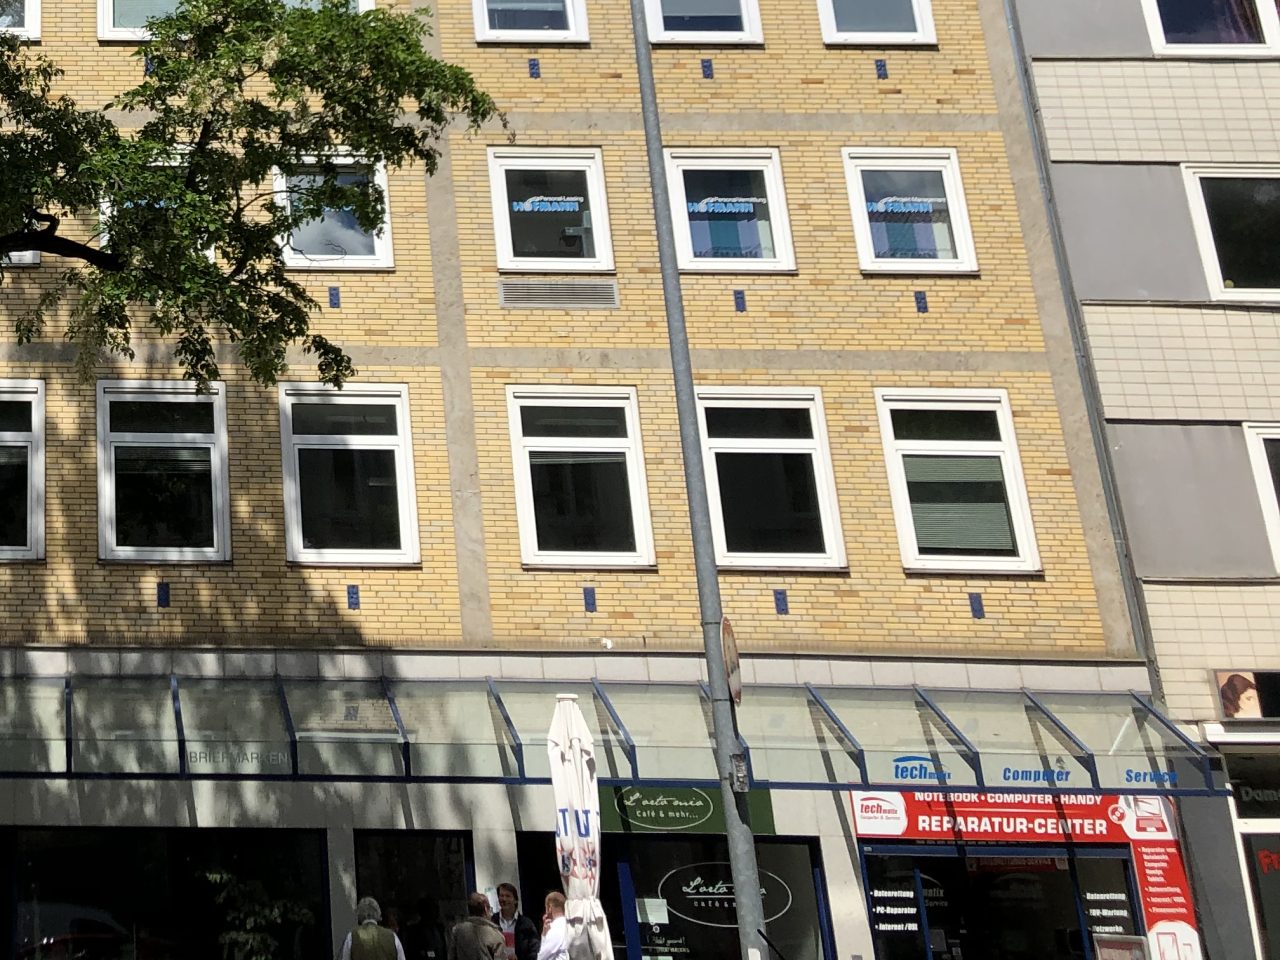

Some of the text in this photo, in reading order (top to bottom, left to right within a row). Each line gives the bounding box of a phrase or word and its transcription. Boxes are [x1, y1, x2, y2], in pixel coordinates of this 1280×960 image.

[512, 201, 579, 211] HOFMANN
[687, 202, 754, 212] HOFMANN
[867, 202, 933, 212] HOFMANN
[1003, 767, 1071, 782] Computer
[1125, 769, 1179, 783] Service
[914, 792, 1102, 805] NOTEBOOK COMPUTER HANDY
[918, 815, 1107, 835] REPARATUR-CENTER
[876, 906, 917, 914] PC-Reparatur
